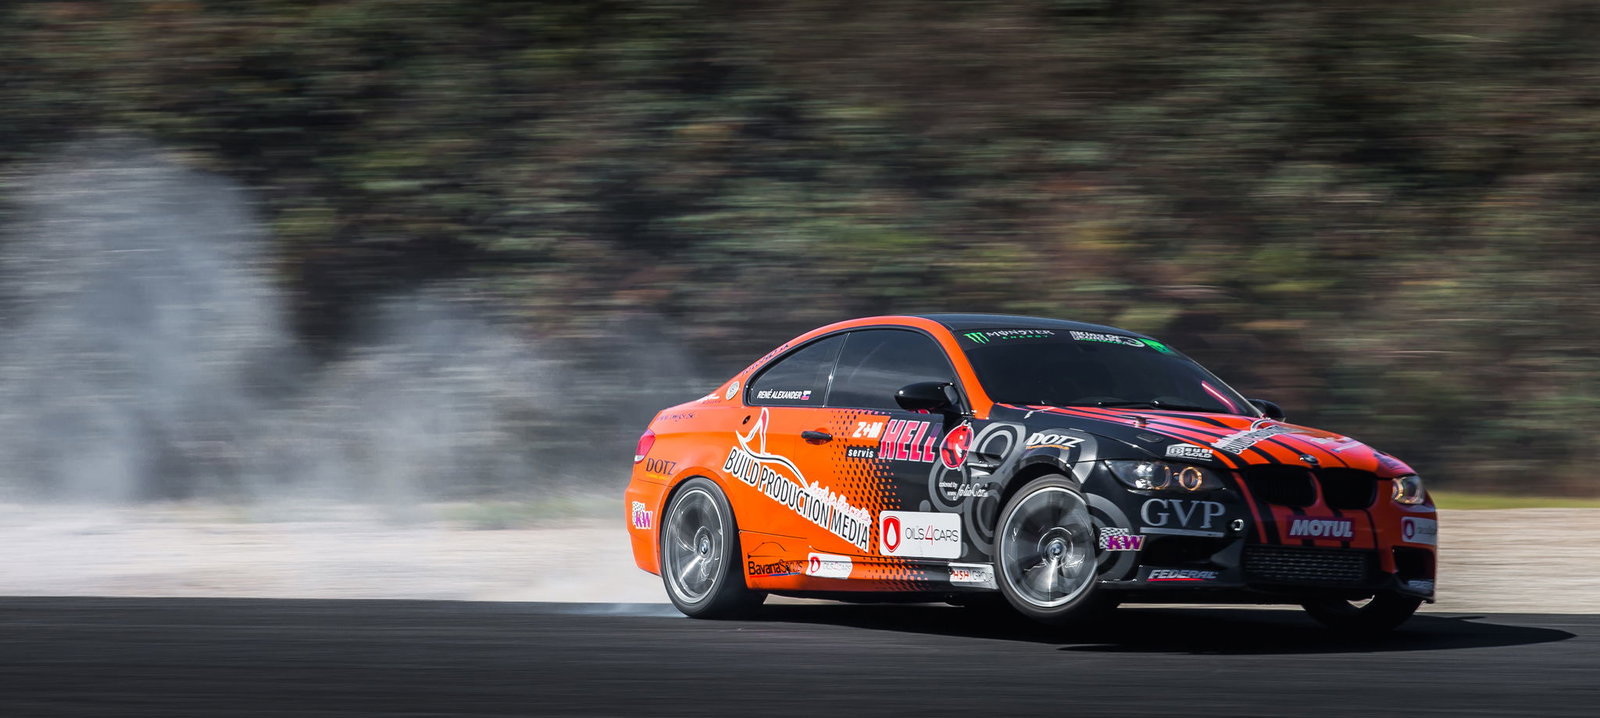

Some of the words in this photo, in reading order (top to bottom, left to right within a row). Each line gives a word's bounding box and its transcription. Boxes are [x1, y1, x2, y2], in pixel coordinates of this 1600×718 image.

[985, 329, 1055, 337] MONSTER
[756, 388, 773, 399] RENÉ
[771, 390, 802, 399] ALEXANDER
[878, 419, 943, 463] HELL
[1024, 432, 1085, 448] DOTZ
[848, 448, 874, 458] servis
[645, 458, 677, 475] DOTZ
[724, 448, 760, 485] BUILD
[758, 466, 830, 528] PRODUCTION
[830, 508, 870, 550] MEDIA
[635, 511, 653, 529] KW
[1140, 498, 1226, 529] GVP
[1289, 519, 1353, 538] MOTUL
[1106, 534, 1147, 551] KW
[1148, 569, 1218, 579] FEDERAL
